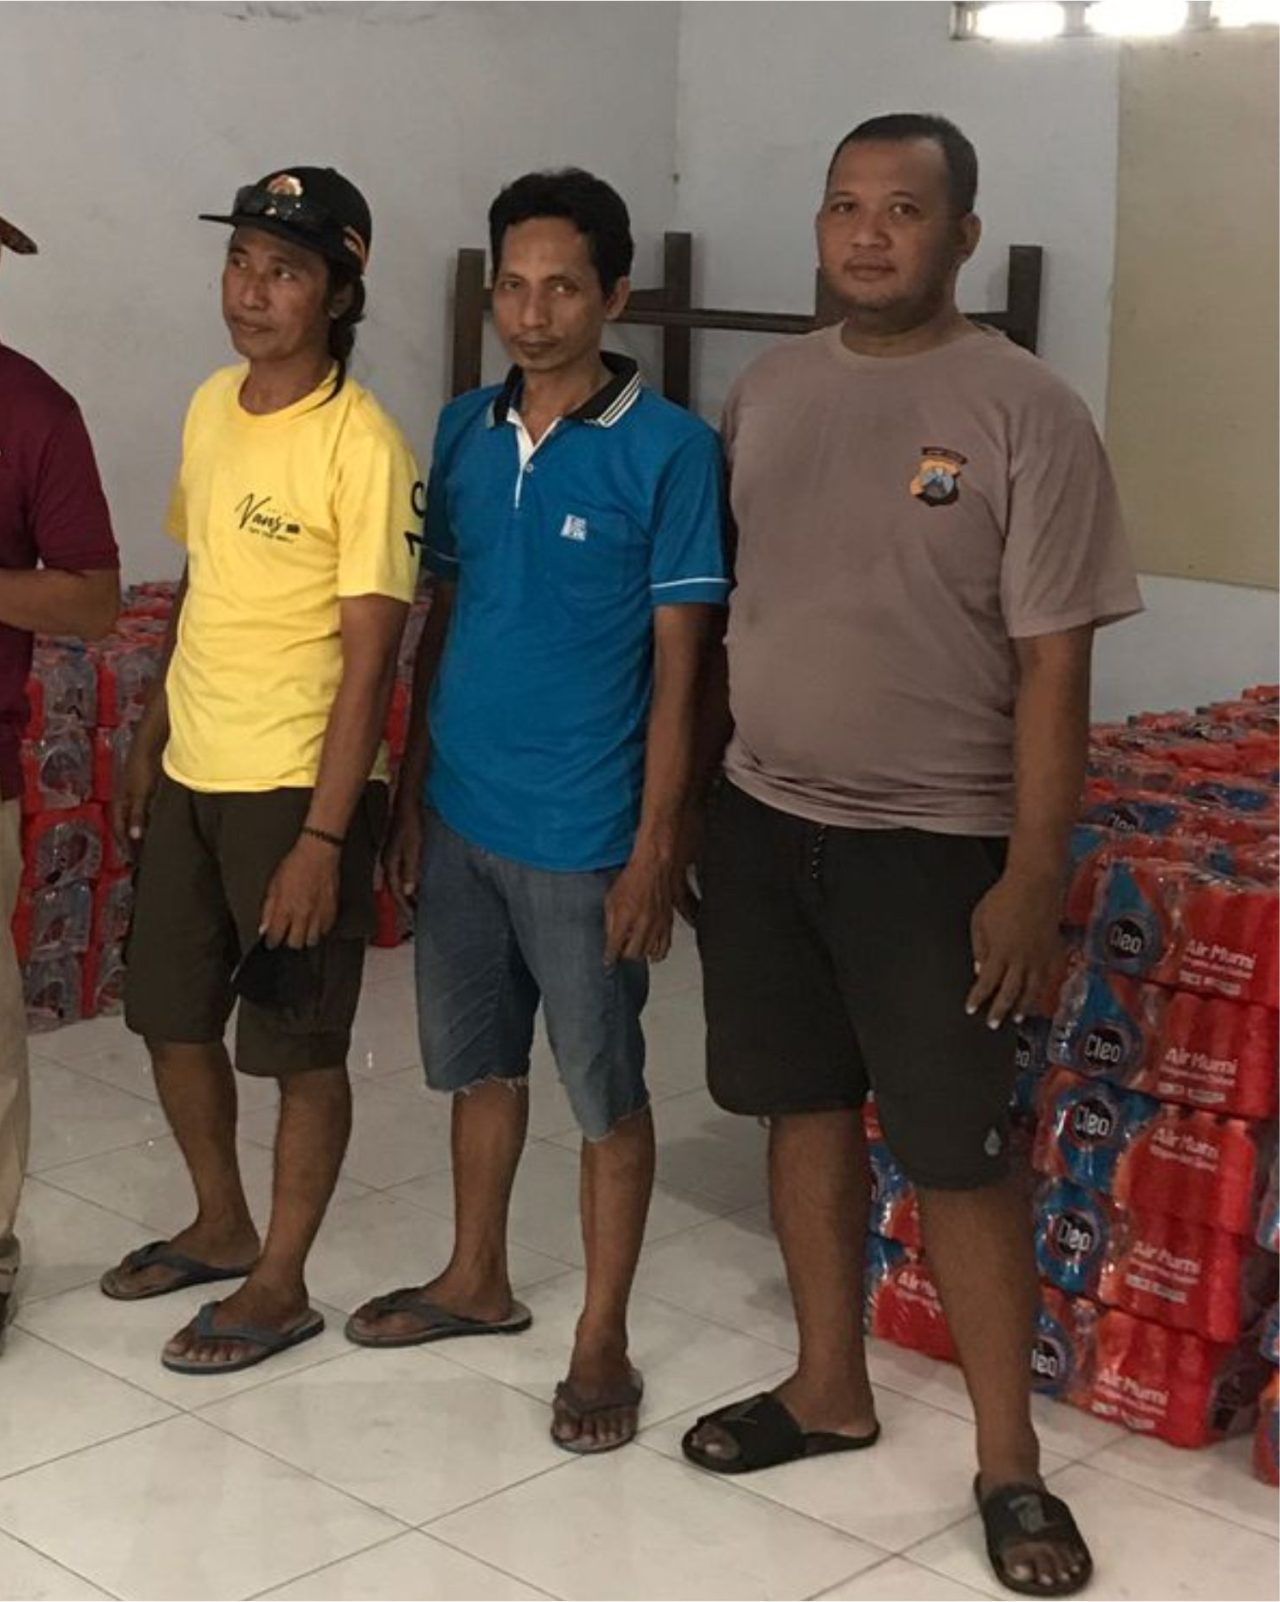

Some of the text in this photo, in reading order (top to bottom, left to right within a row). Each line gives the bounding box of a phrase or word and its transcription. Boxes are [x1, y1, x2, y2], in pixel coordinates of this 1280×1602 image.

[234, 492, 286, 534] Vans
[1085, 1035, 1120, 1063] Cleo
[1165, 1048, 1190, 1066] Air
[1031, 1349, 1058, 1377] leo
